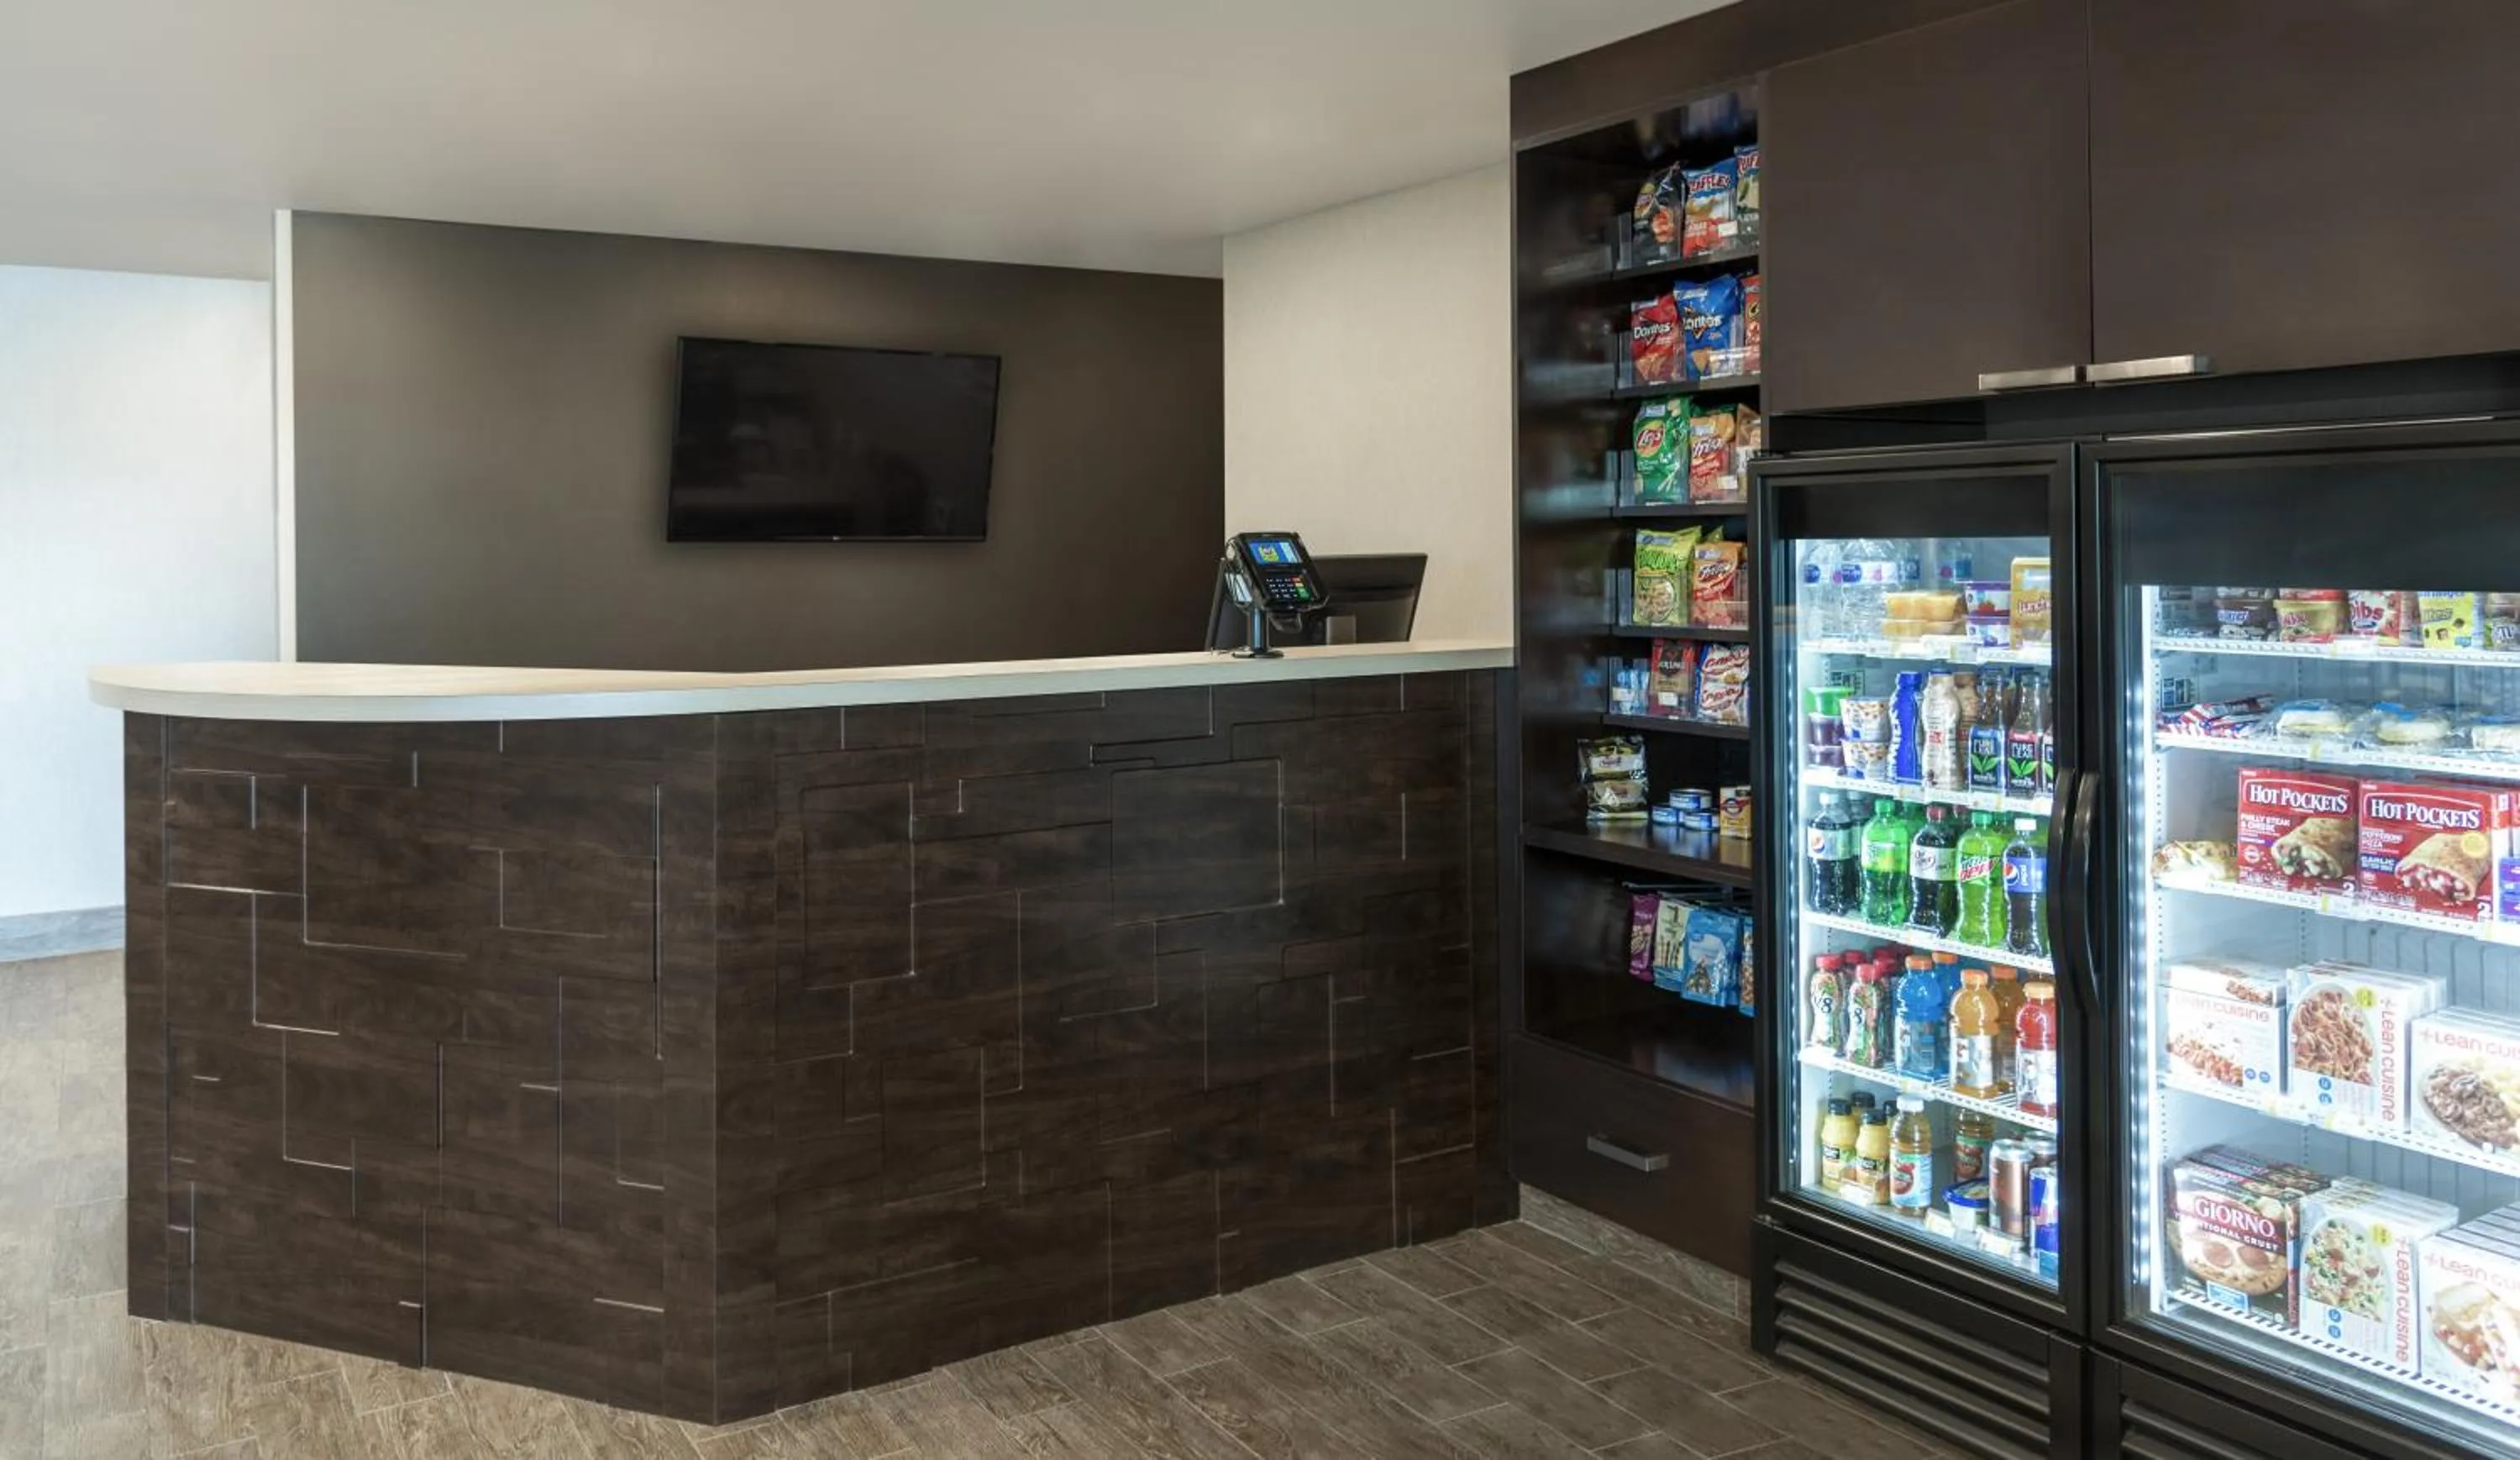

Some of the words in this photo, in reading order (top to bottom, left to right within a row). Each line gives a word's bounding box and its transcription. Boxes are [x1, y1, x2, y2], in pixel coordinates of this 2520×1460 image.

[1633, 322, 1671, 339] Doritos
[2249, 784, 2280, 806] HOT
[2281, 788, 2349, 814] POCKETS
[2370, 799, 2404, 821] HOT
[2405, 802, 2481, 830] POCKETS
[2194, 1198, 2275, 1238] GIORNO
